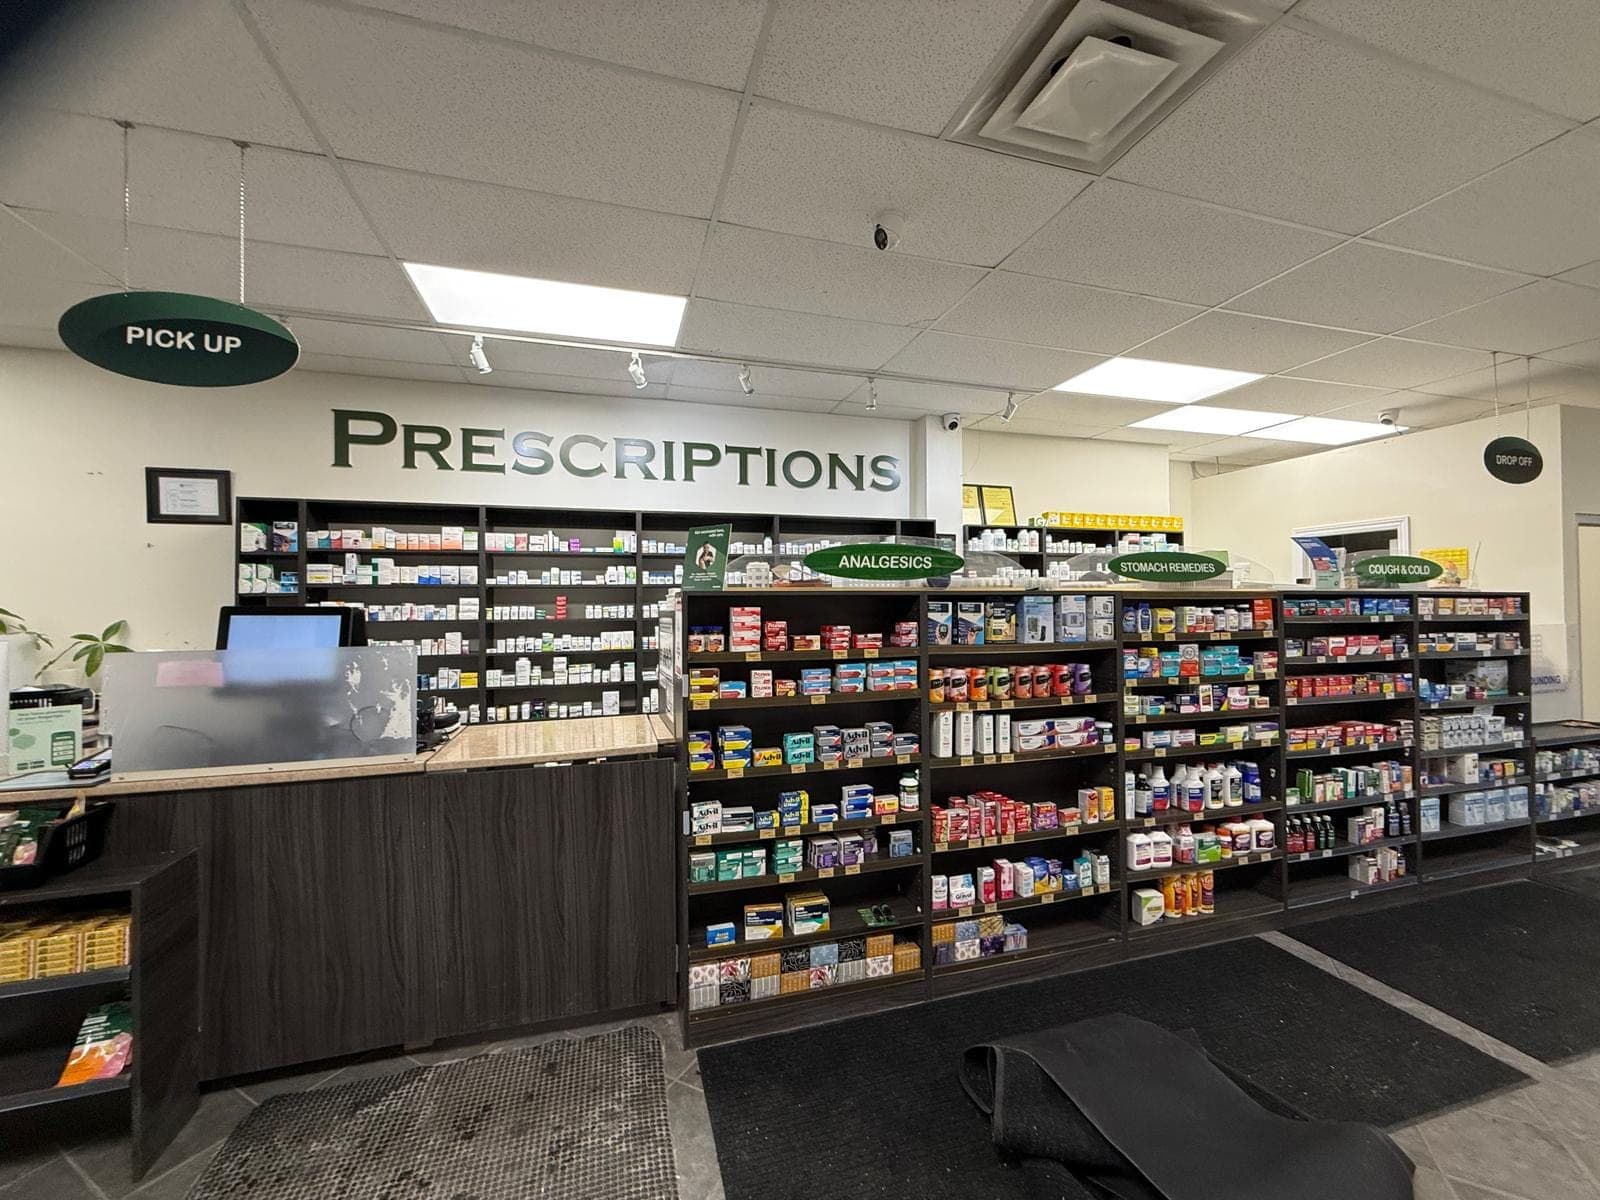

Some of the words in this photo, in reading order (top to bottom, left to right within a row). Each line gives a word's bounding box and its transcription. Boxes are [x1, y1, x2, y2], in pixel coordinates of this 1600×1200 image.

[126, 326, 196, 352] PICK
[204, 333, 242, 355] UP
[331, 408, 901, 492] PRESCRIPTIONS
[1496, 454, 1517, 466] DROP
[1518, 456, 1533, 467] OFF
[839, 553, 933, 570] ANALGESICS
[1120, 561, 1168, 573] STOMACH
[1169, 561, 1216, 574] REMEDIES
[1368, 564, 1400, 575] COUGH
[1401, 565, 1407, 574] &
[1408, 564, 1431, 575] COLD
[791, 737, 811, 746] Advil
[846, 731, 868, 742] Advil
[847, 744, 869, 755] Advil
[762, 752, 782, 762] Advil
[791, 751, 811, 760] Advil
[784, 796, 801, 804] Advil
[697, 807, 719, 817] Advil
[759, 815, 773, 823] Advil
[697, 821, 718, 831] Advil
